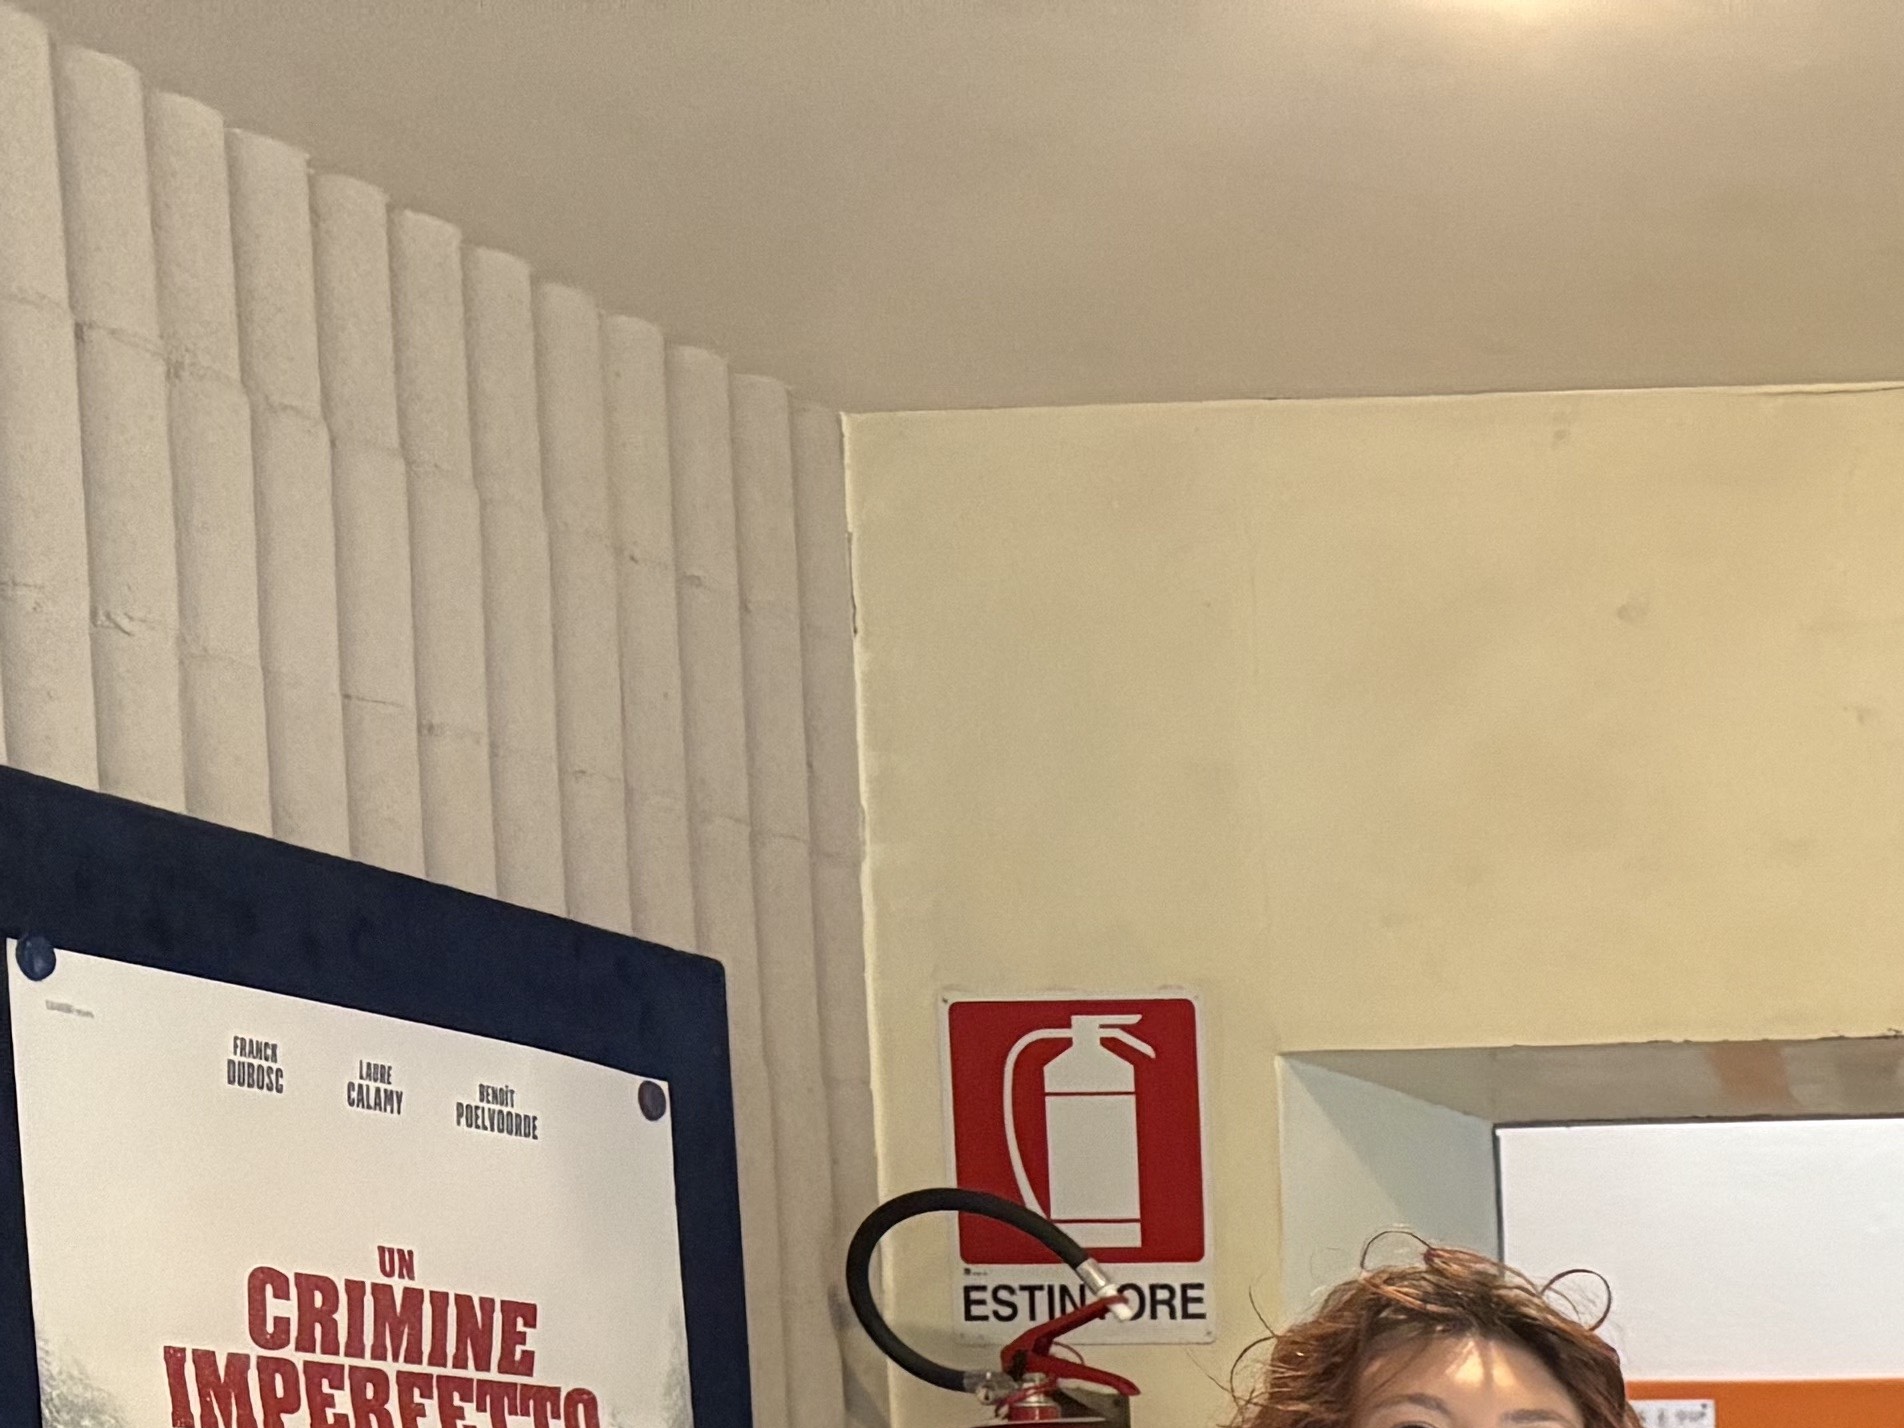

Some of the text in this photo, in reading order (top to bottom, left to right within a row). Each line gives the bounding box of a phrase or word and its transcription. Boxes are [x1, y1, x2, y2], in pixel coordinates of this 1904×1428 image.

[233, 1035, 278, 1063] FRANCK
[227, 1059, 284, 1094] DUBOSC
[359, 1059, 392, 1085] LAURE
[347, 1081, 403, 1115] CALAMY
[456, 1102, 538, 1140] POELVOORDE
[377, 1245, 415, 1281] UN
[963, 1283, 1206, 1322] ESTINORE
[247, 1266, 537, 1377] CRIMINE
